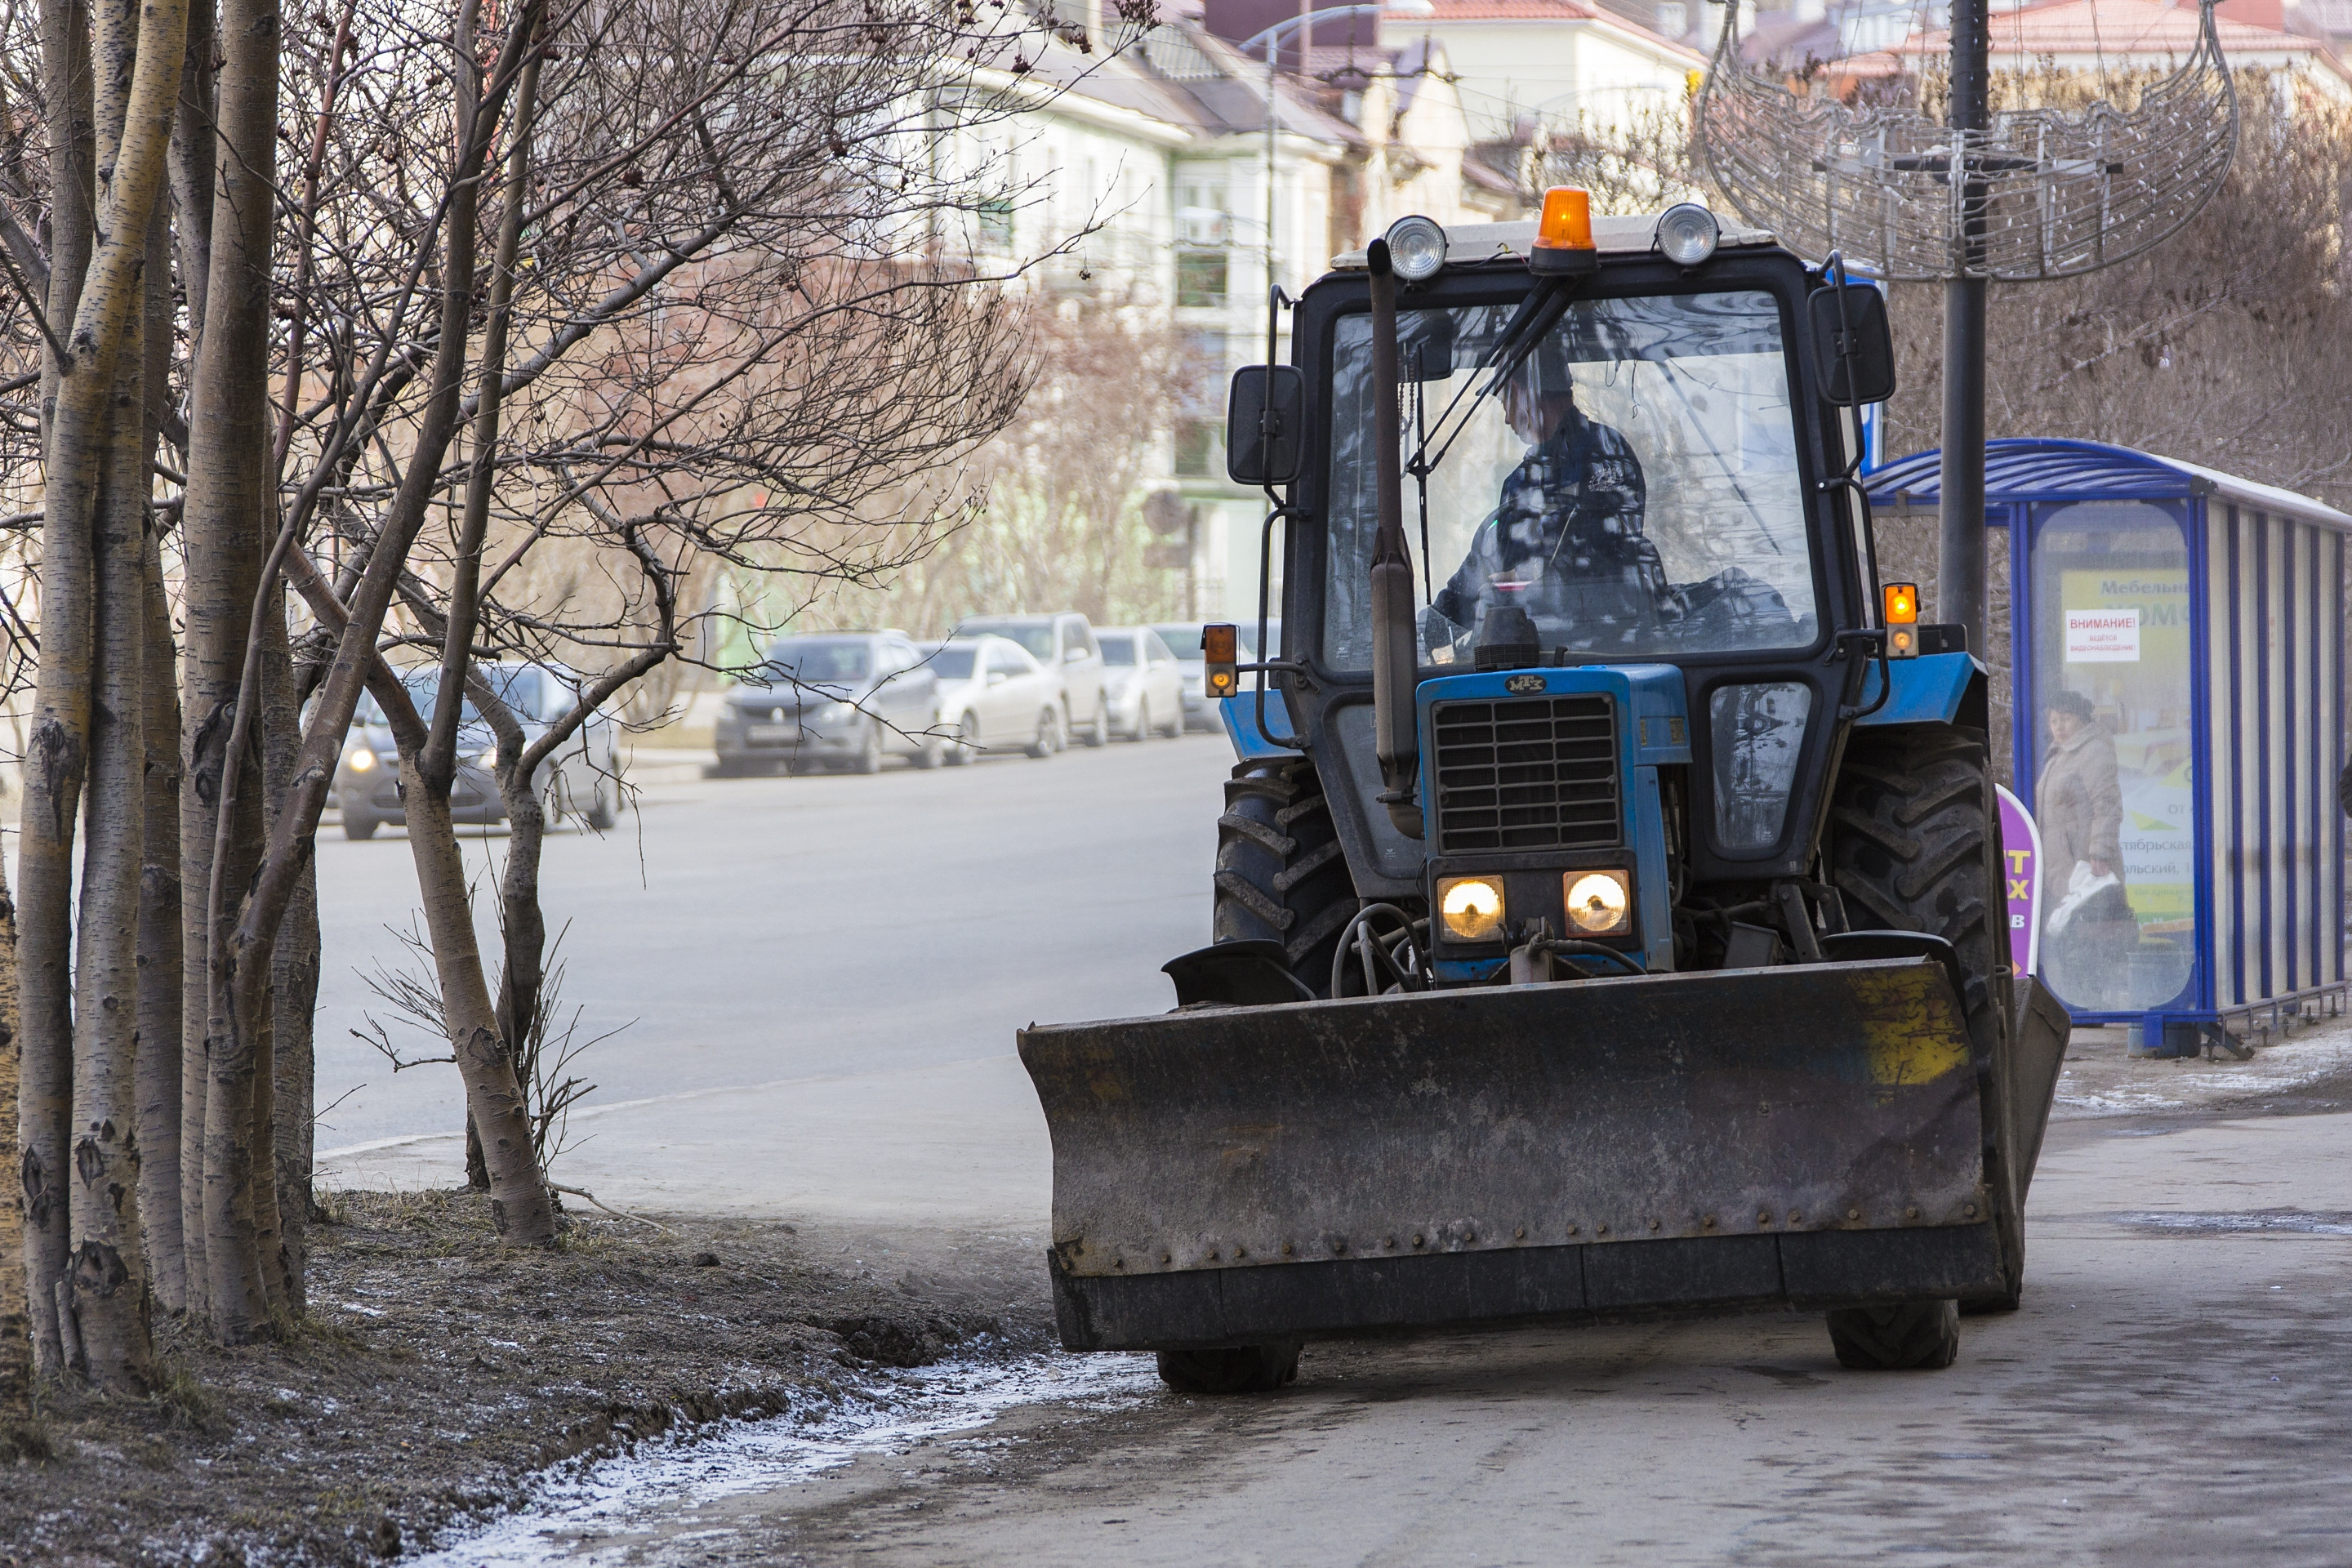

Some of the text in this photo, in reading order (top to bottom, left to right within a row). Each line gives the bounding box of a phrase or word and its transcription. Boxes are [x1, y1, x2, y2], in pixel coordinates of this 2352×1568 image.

[2070, 617, 2136, 629] ВНИМАНИЕ!
[2089, 634, 2118, 642] ВЕДЁТСЯ
[2070, 644, 2136, 652] ВИДЕОНАБЛЮДЕНИЕ!
[2123, 862, 2180, 875] ольский,
